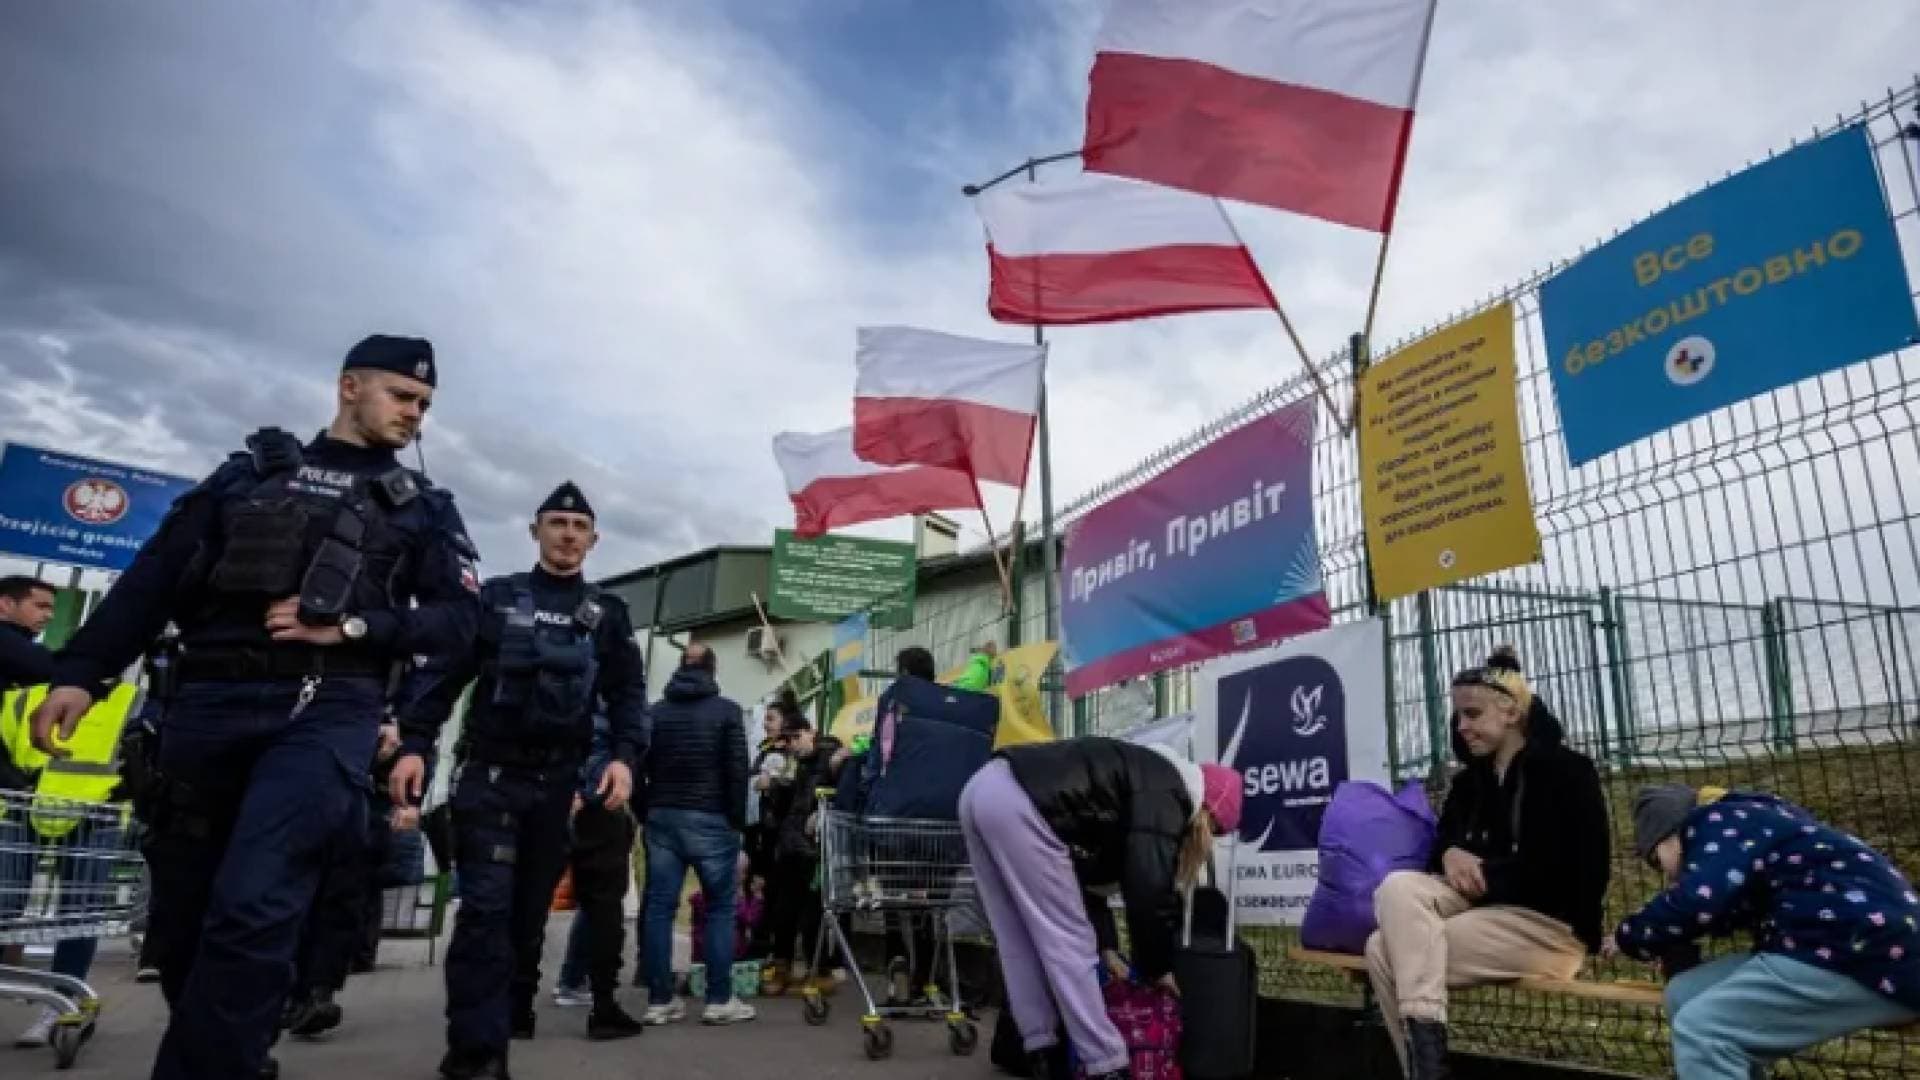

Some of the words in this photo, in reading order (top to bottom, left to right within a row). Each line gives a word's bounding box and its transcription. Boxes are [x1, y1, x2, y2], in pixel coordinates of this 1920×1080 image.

[1564, 228, 1863, 376] безкоштовно
[1632, 232, 1714, 288] Все
[1071, 538, 1156, 602] Привіт,
[1166, 479, 1287, 558] Привіт
[1244, 755, 1330, 798] sewa
